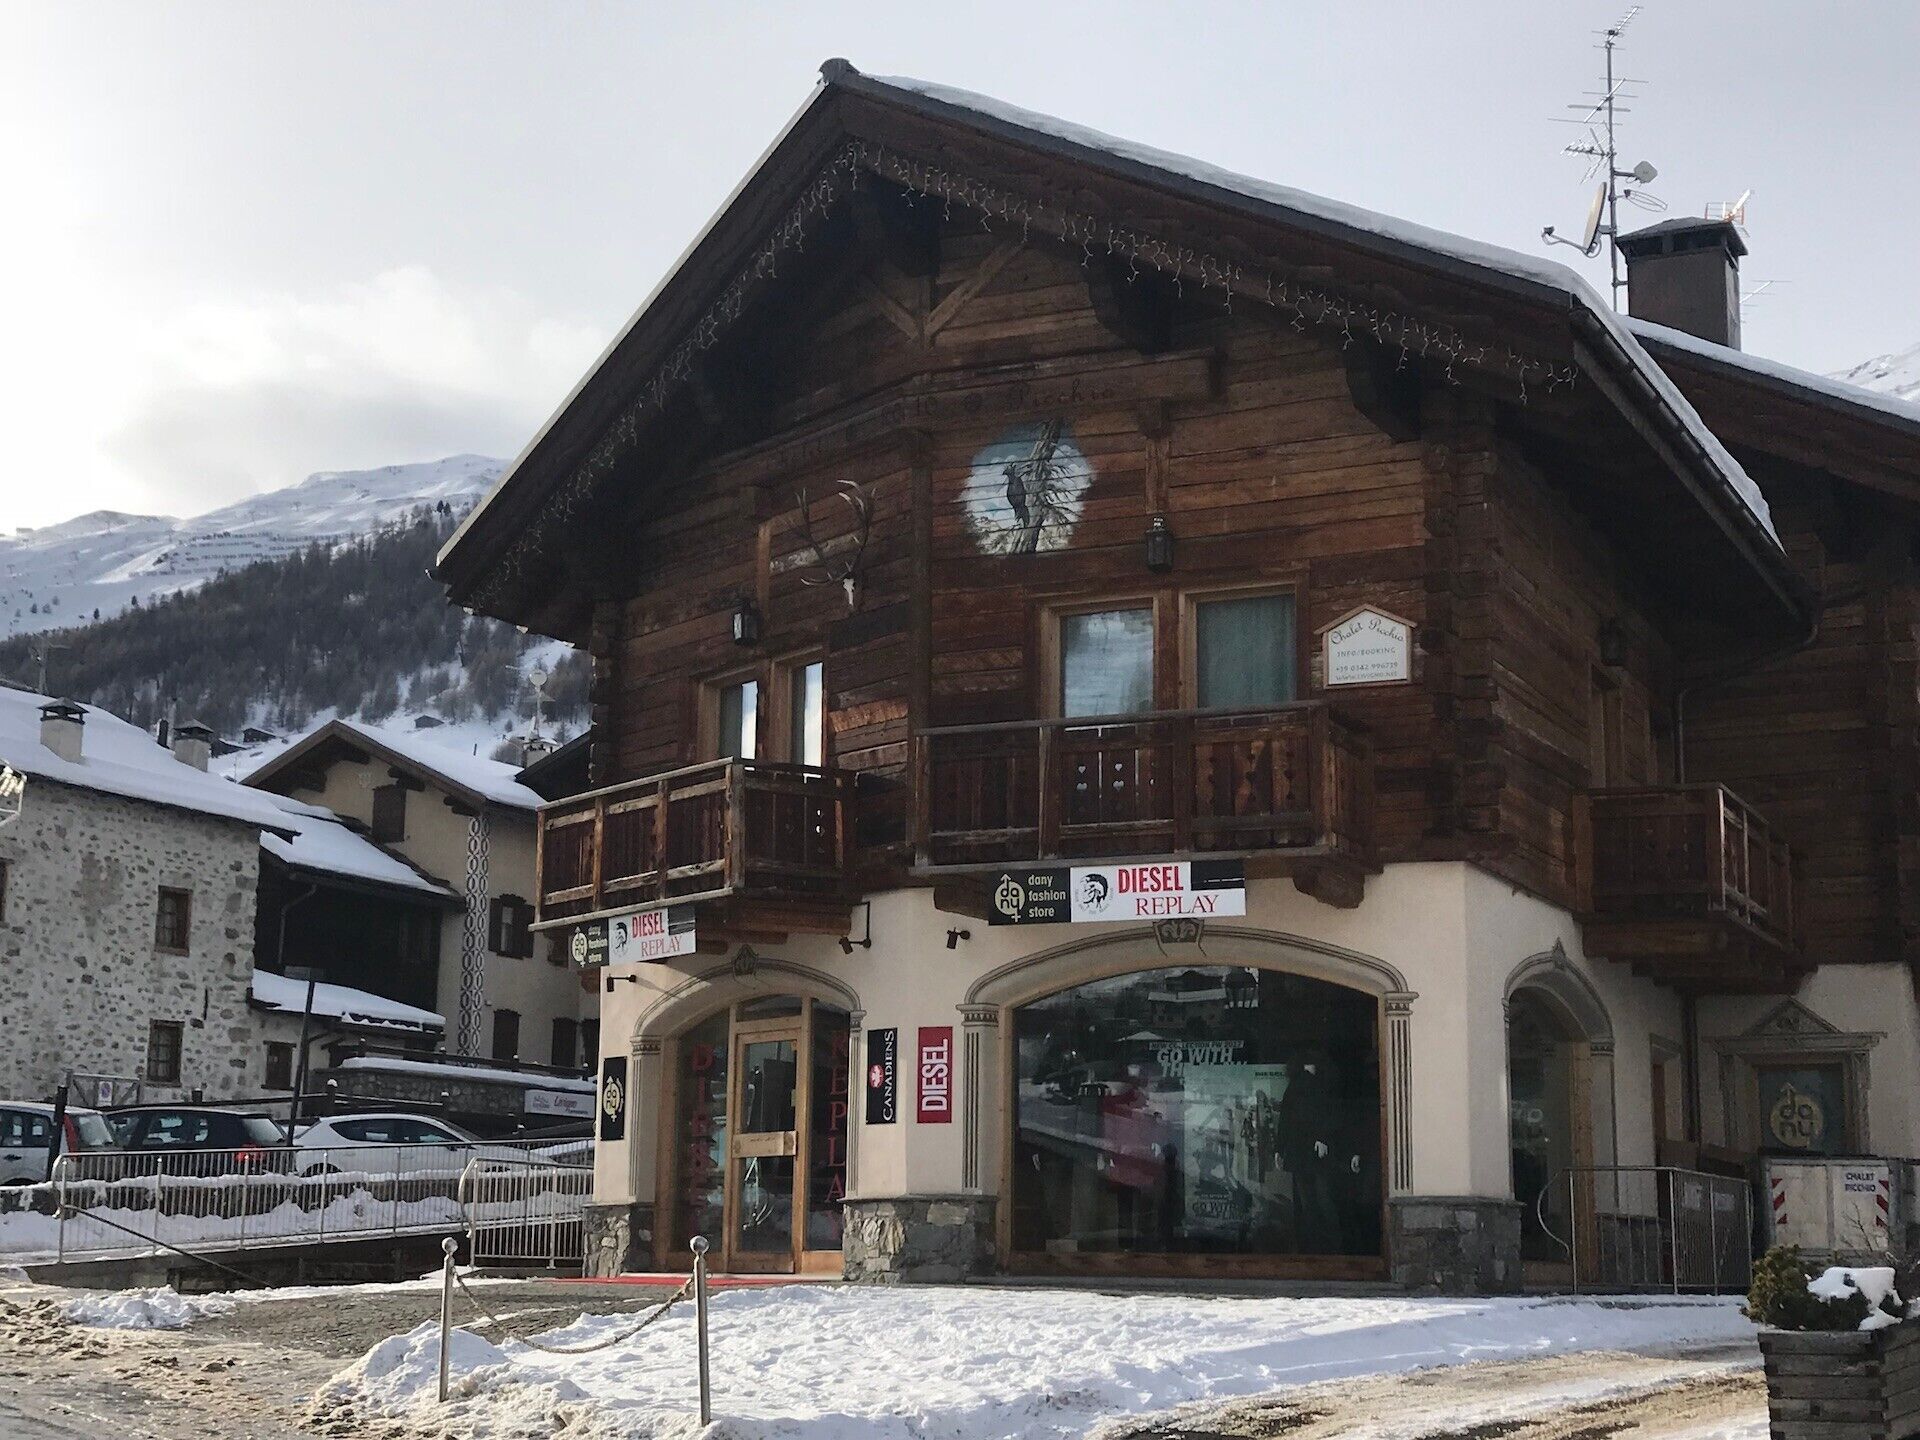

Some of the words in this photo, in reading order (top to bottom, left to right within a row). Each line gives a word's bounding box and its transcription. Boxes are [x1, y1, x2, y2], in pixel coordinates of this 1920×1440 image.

[1331, 622, 1364, 645] Chalet
[1027, 874, 1053, 888] dany
[1117, 865, 1184, 893] DIESEL
[1028, 888, 1066, 903] fashion
[1135, 894, 1219, 916] REPLAY
[1028, 906, 1055, 919] store
[631, 911, 665, 939] DIESEL
[641, 935, 683, 958] REPLAY
[1156, 1048, 1183, 1064] GO
[1187, 1046, 1234, 1065] WITH
[882, 1030, 895, 1121] CANADIENS
[921, 1038, 949, 1112] DIESEL
[1845, 1173, 1876, 1182] CHALET
